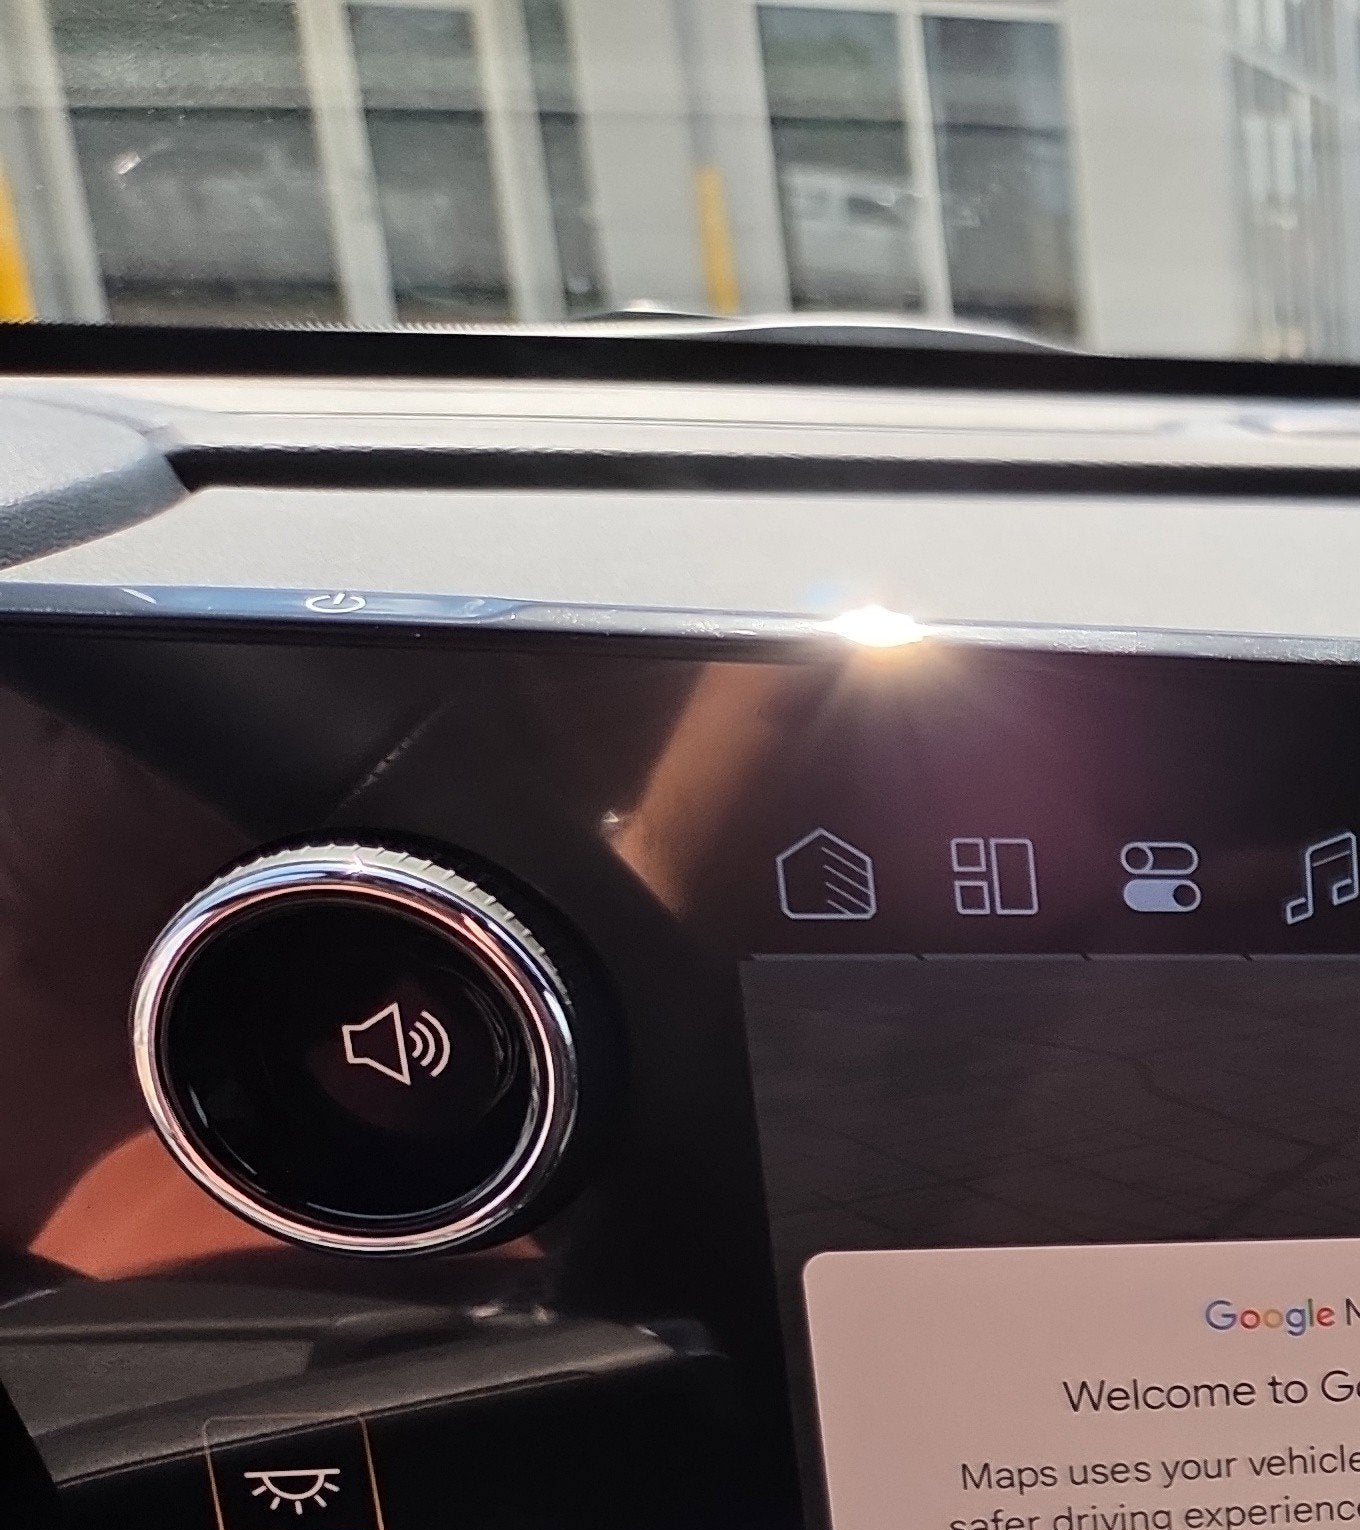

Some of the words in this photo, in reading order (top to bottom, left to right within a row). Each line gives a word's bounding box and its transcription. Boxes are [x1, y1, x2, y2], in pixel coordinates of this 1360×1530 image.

[1205, 1298, 1335, 1336] Google
[1062, 1378, 1256, 1412] Welcome
[1267, 1376, 1308, 1404] to
[961, 1462, 1058, 1496] Maps
[1068, 1461, 1152, 1486] uses
[1160, 1457, 1238, 1489] your
